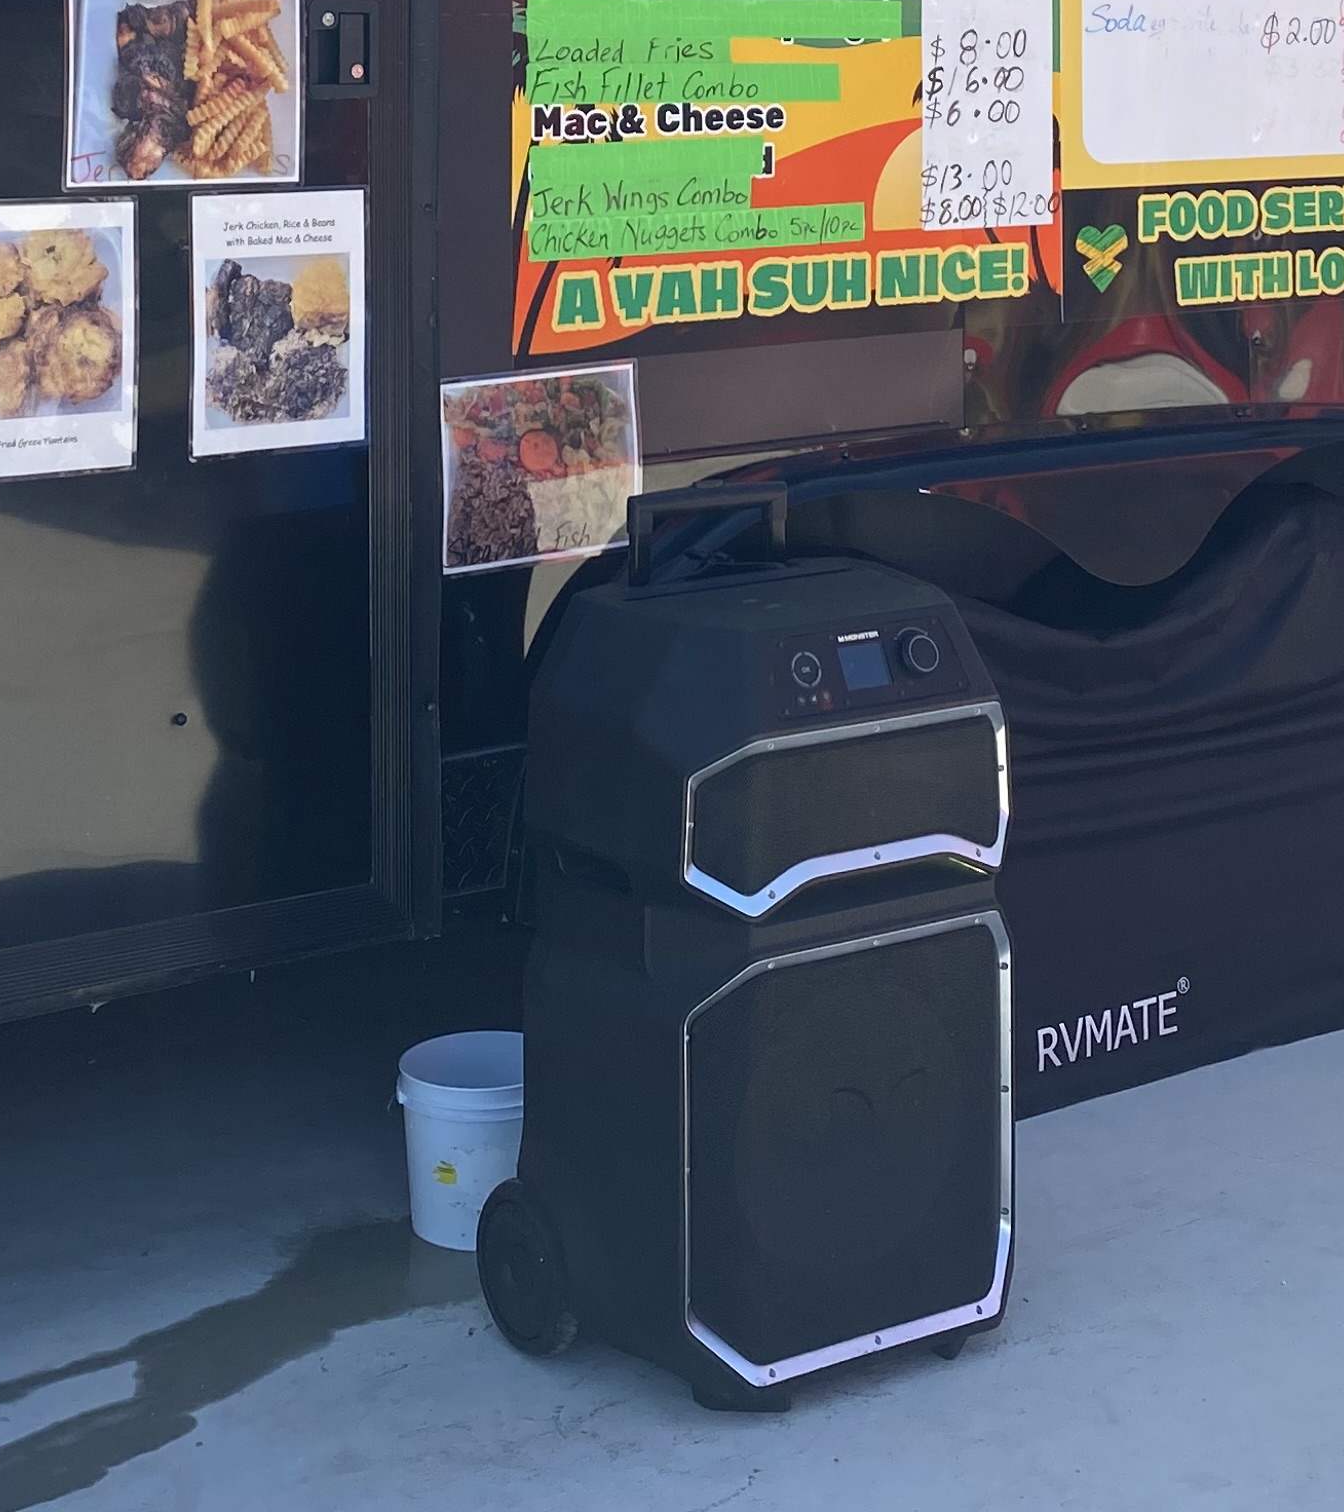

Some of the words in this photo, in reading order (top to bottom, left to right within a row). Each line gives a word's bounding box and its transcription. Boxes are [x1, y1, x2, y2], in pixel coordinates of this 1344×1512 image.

[533, 103, 612, 138] Mac
[618, 104, 646, 135] &
[656, 101, 786, 133] Cheese
[531, 218, 610, 254] Chicken
[619, 219, 708, 254] Nuggets
[714, 213, 779, 240] Combo
[1140, 191, 1258, 241] FOOD
[556, 276, 601, 326] A
[613, 265, 741, 320] YAH
[751, 258, 867, 310] SUH
[879, 245, 1027, 298] NICE!
[1178, 253, 1293, 304] WITH
